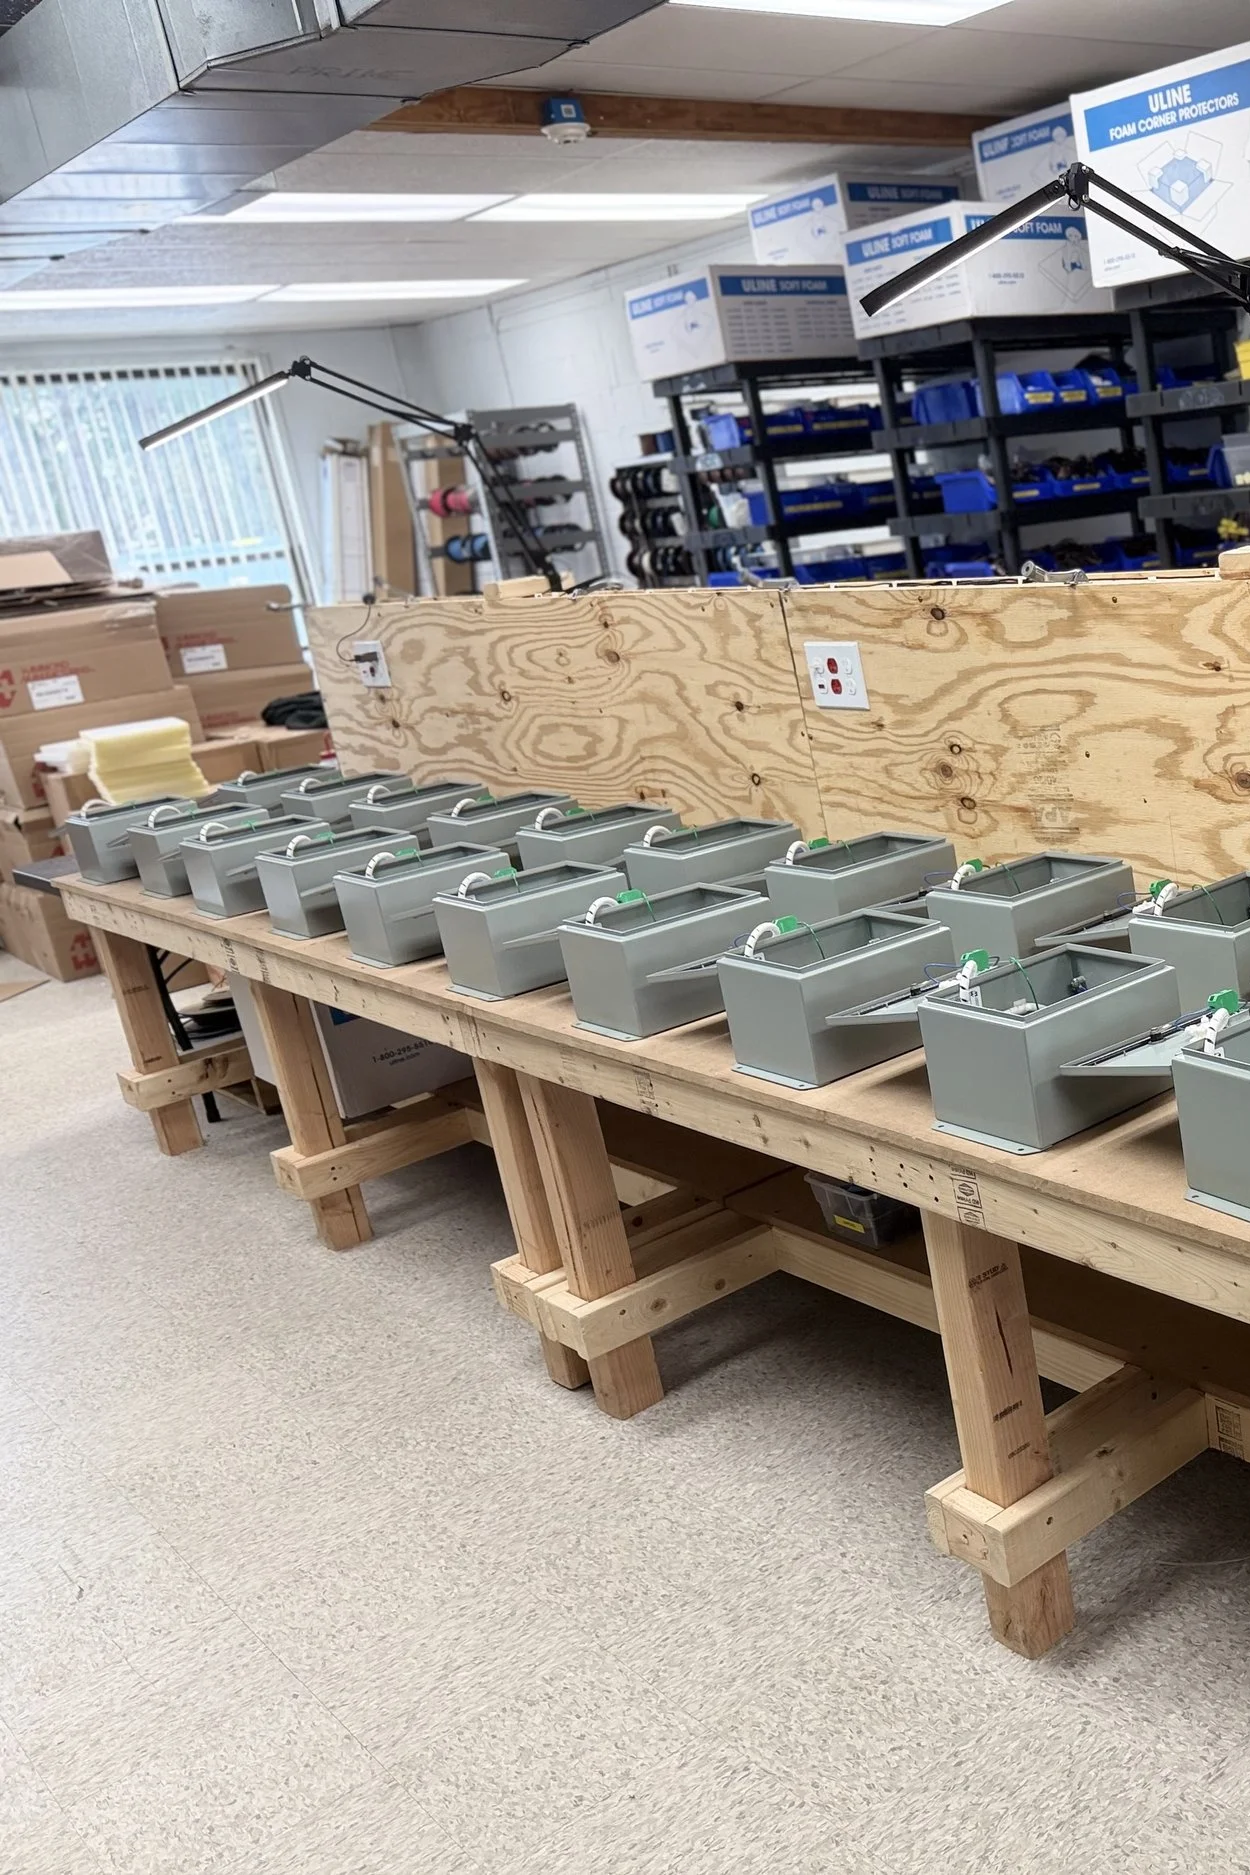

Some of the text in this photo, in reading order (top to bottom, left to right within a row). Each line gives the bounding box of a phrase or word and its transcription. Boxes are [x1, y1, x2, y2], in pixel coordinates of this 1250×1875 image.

[1148, 84, 1192, 111] ULINE
[1109, 92, 1240, 141] FOAM CORNER PROTECTORS
[867, 186, 943, 200] ULINE SOFT FOAM
[754, 204, 777, 224] ULINE
[1036, 221, 1062, 234] FOAM
[861, 228, 934, 258] ULINE SOFT FOAM
[741, 279, 828, 292] ULINE SOFT FOAM
